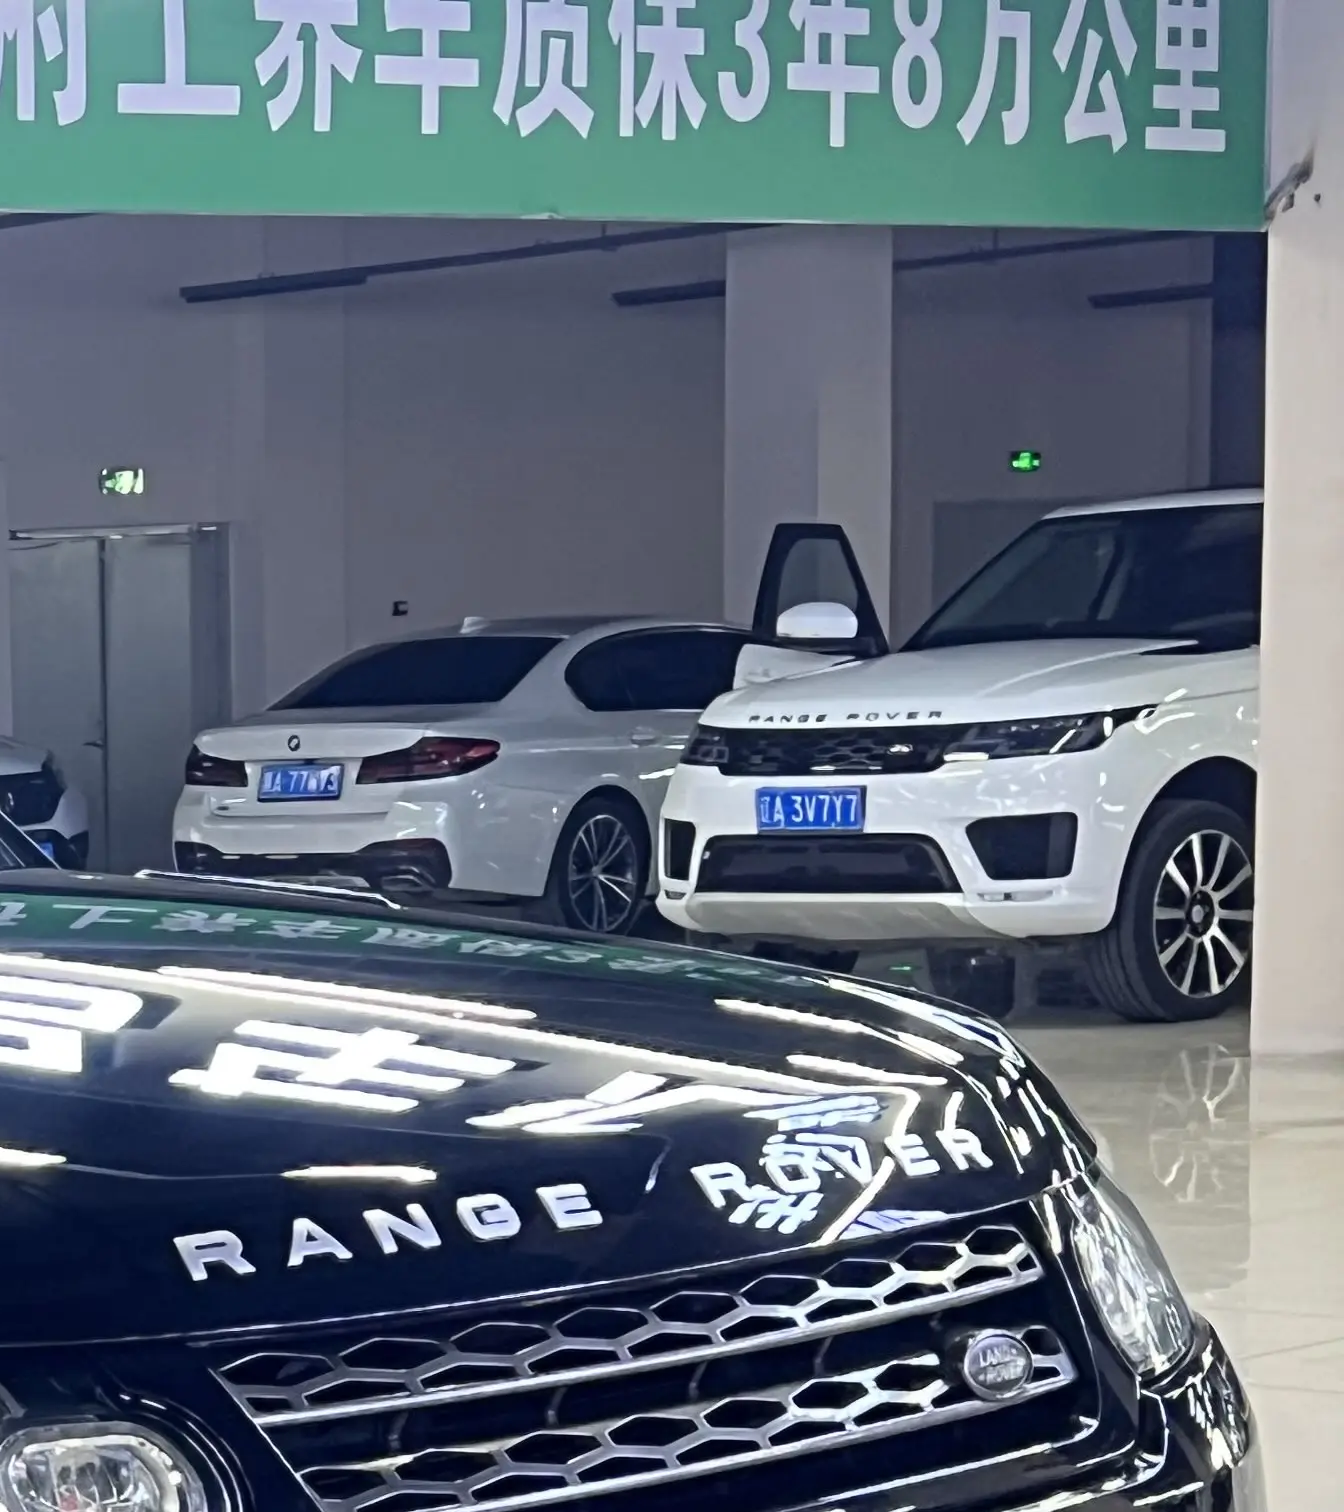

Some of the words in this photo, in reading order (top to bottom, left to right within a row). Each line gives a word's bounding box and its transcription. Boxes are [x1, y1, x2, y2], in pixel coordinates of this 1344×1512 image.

[748, 714, 828, 724] RANGE
[846, 710, 943, 722] ROVER
[173, 1182, 603, 1281] RANGE
[690, 1127, 994, 1209] ROVER
